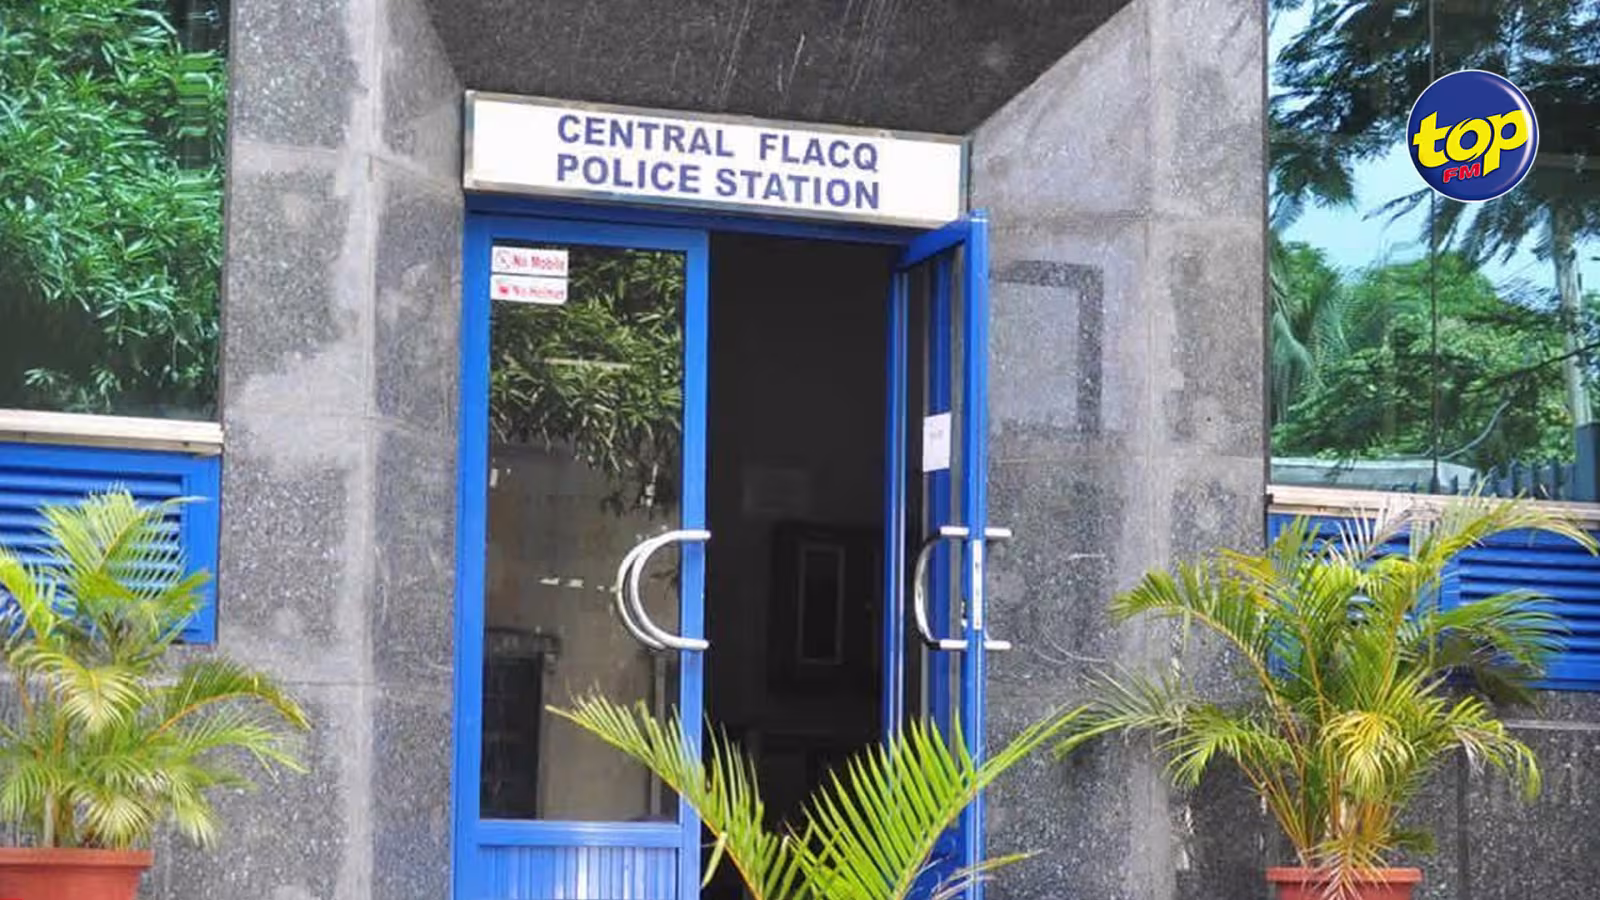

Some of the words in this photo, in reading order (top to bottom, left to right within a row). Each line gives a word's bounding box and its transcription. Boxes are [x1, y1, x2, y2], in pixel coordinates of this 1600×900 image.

[558, 114, 734, 157] CENTRAL
[759, 133, 878, 173] FLACQ
[557, 153, 701, 193] POLICE
[715, 168, 879, 209] STATION
